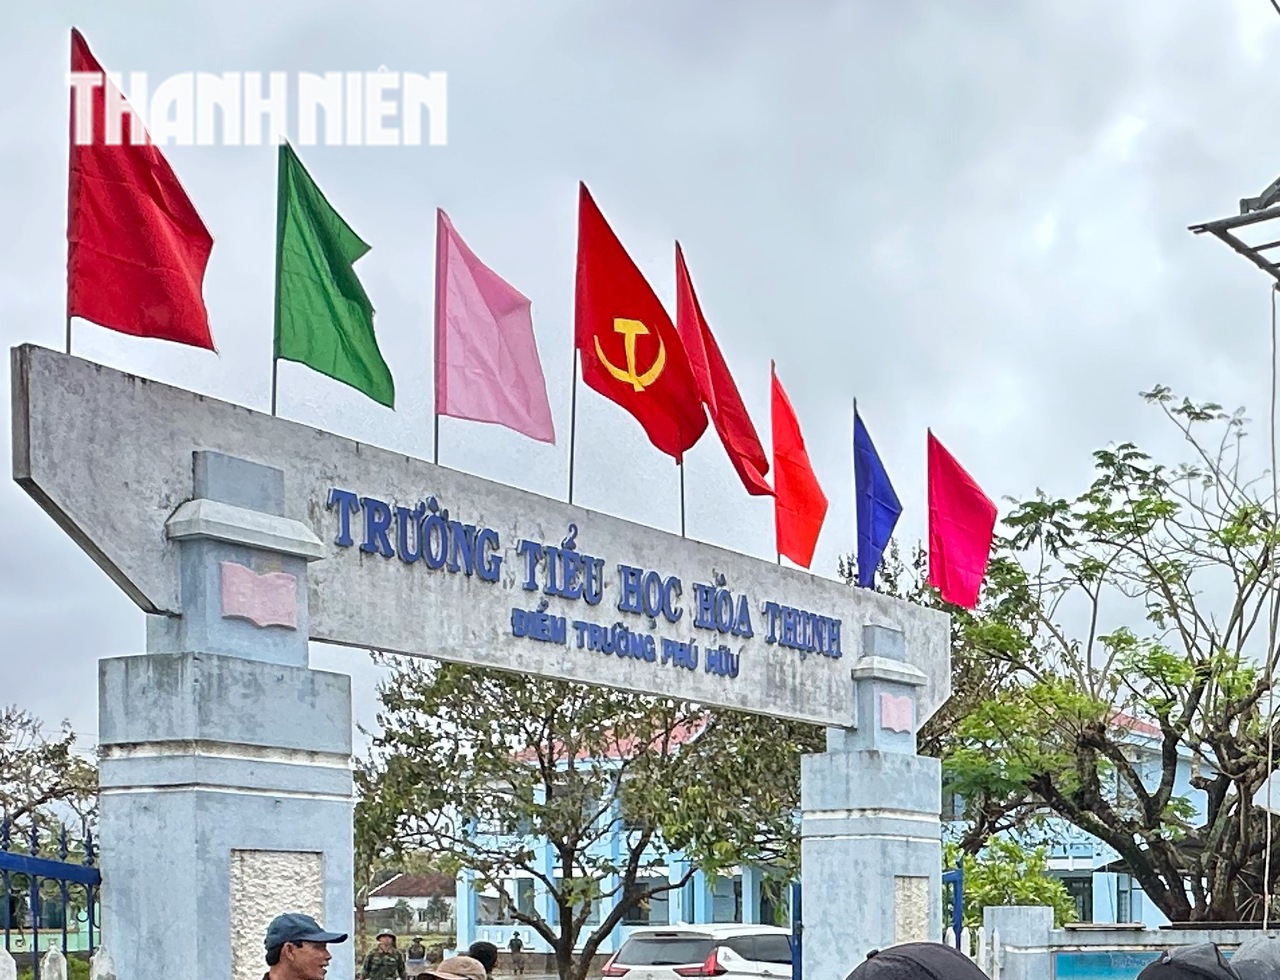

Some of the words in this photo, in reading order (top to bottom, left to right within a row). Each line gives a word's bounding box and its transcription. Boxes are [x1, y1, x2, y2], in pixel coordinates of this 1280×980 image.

[326, 487, 503, 583] TRƯỜNG
[516, 523, 605, 606] TIỂU
[618, 564, 683, 630] HỌC
[693, 568, 754, 639] HÒA
[762, 601, 843, 661] THỊNH
[572, 622, 657, 663] TRƯỜNG
[661, 637, 699, 671] PHÚ
